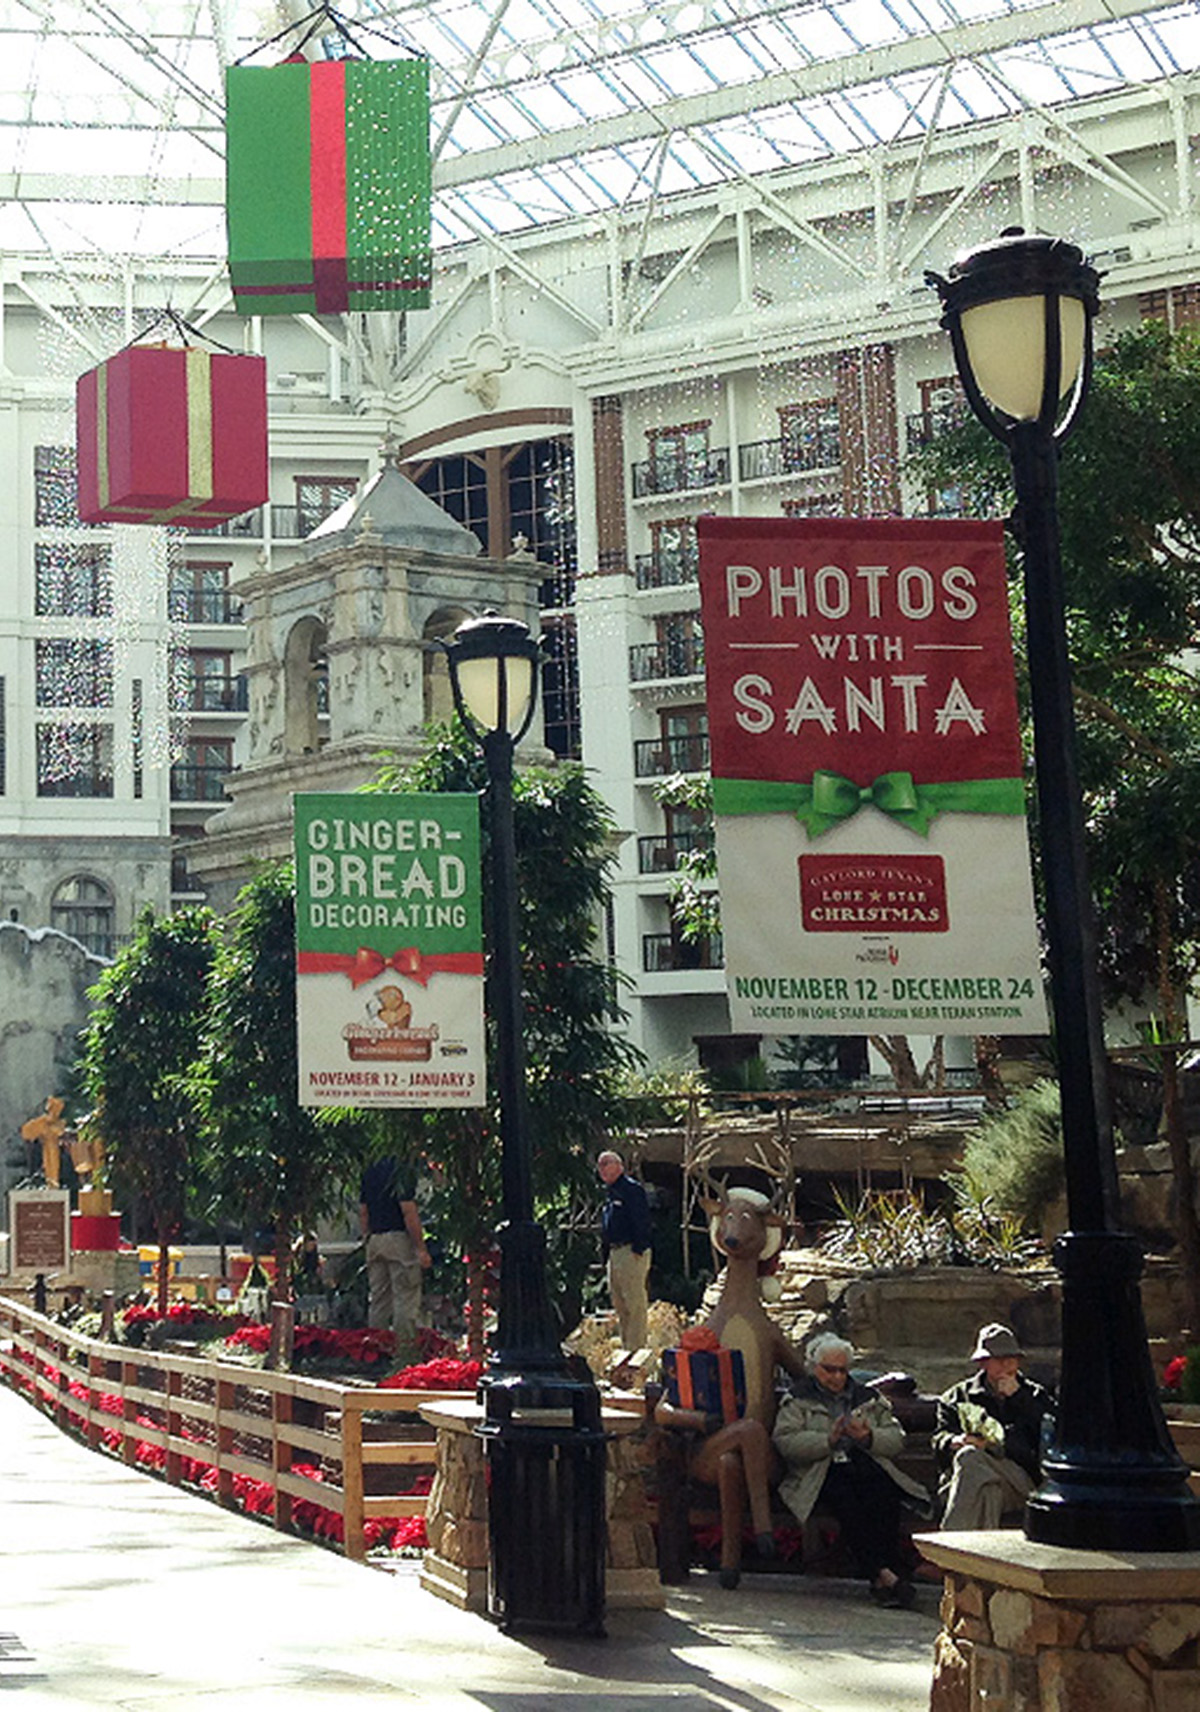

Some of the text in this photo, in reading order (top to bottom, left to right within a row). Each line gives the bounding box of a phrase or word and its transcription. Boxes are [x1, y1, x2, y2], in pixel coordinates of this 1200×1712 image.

[725, 565, 978, 620] PHOTOS
[810, 634, 903, 661] WITH
[732, 674, 987, 736] SANTA
[308, 820, 461, 850] GINGER-
[309, 855, 466, 899] BREAD
[822, 891, 927, 902] LONE STAR
[310, 904, 466, 927] DECORATING
[810, 907, 940, 922] CHRISTMAS
[735, 976, 849, 1000] NOVEMBER
[855, 978, 878, 1000] 12
[892, 978, 1003, 1000] DECEMBER
[1007, 978, 1034, 999] 24
[751, 1005, 795, 1018] LOCATED
[797, 1006, 809, 1018] IN
[811, 1006, 838, 1019] LONE
[839, 1006, 866, 1019] STAR
[910, 1006, 939, 1018] NEAR
[977, 1006, 1022, 1018] STATION
[309, 1072, 380, 1086] NOVEMBER
[384, 1073, 398, 1086] 12
[409, 1072, 464, 1086] JANUARY
[467, 1074, 475, 1086] 3
